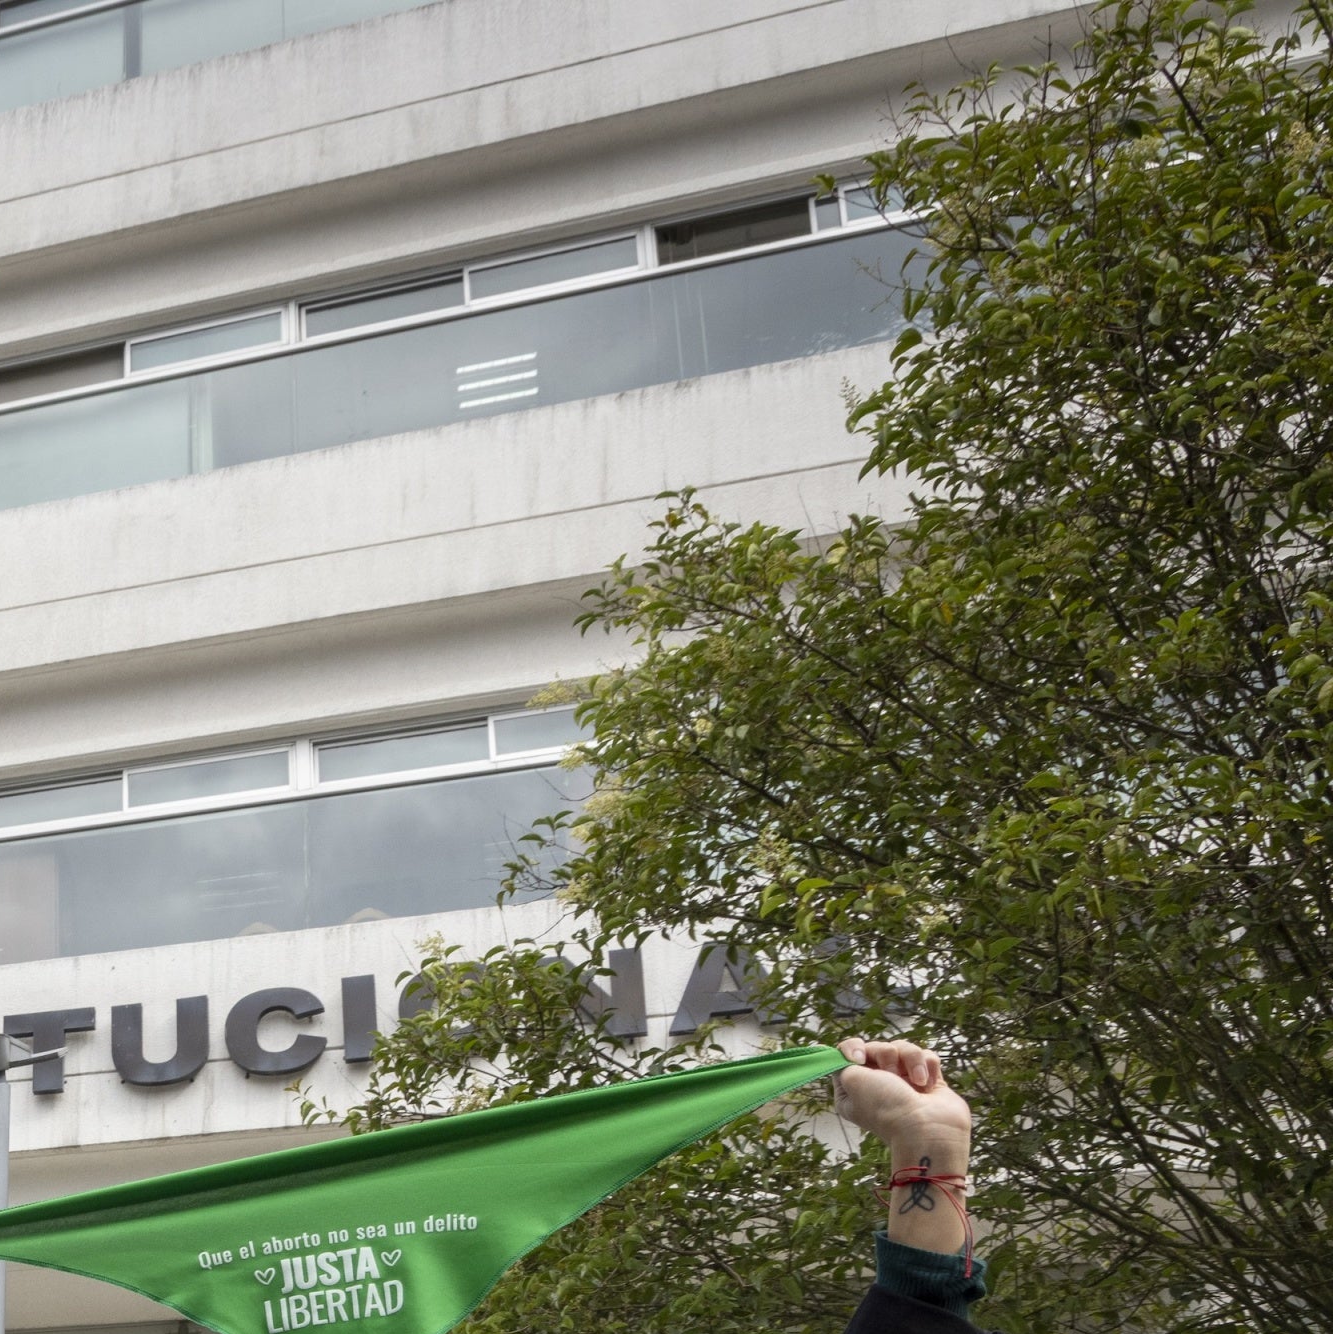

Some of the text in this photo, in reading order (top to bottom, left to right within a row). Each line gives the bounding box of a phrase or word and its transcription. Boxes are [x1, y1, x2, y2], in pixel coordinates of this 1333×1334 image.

[198, 1213, 477, 1269] Que el aborto no sea un delito
[280, 1246, 381, 1294] JUSTA
[263, 1279, 404, 1334] LIBERTAD
